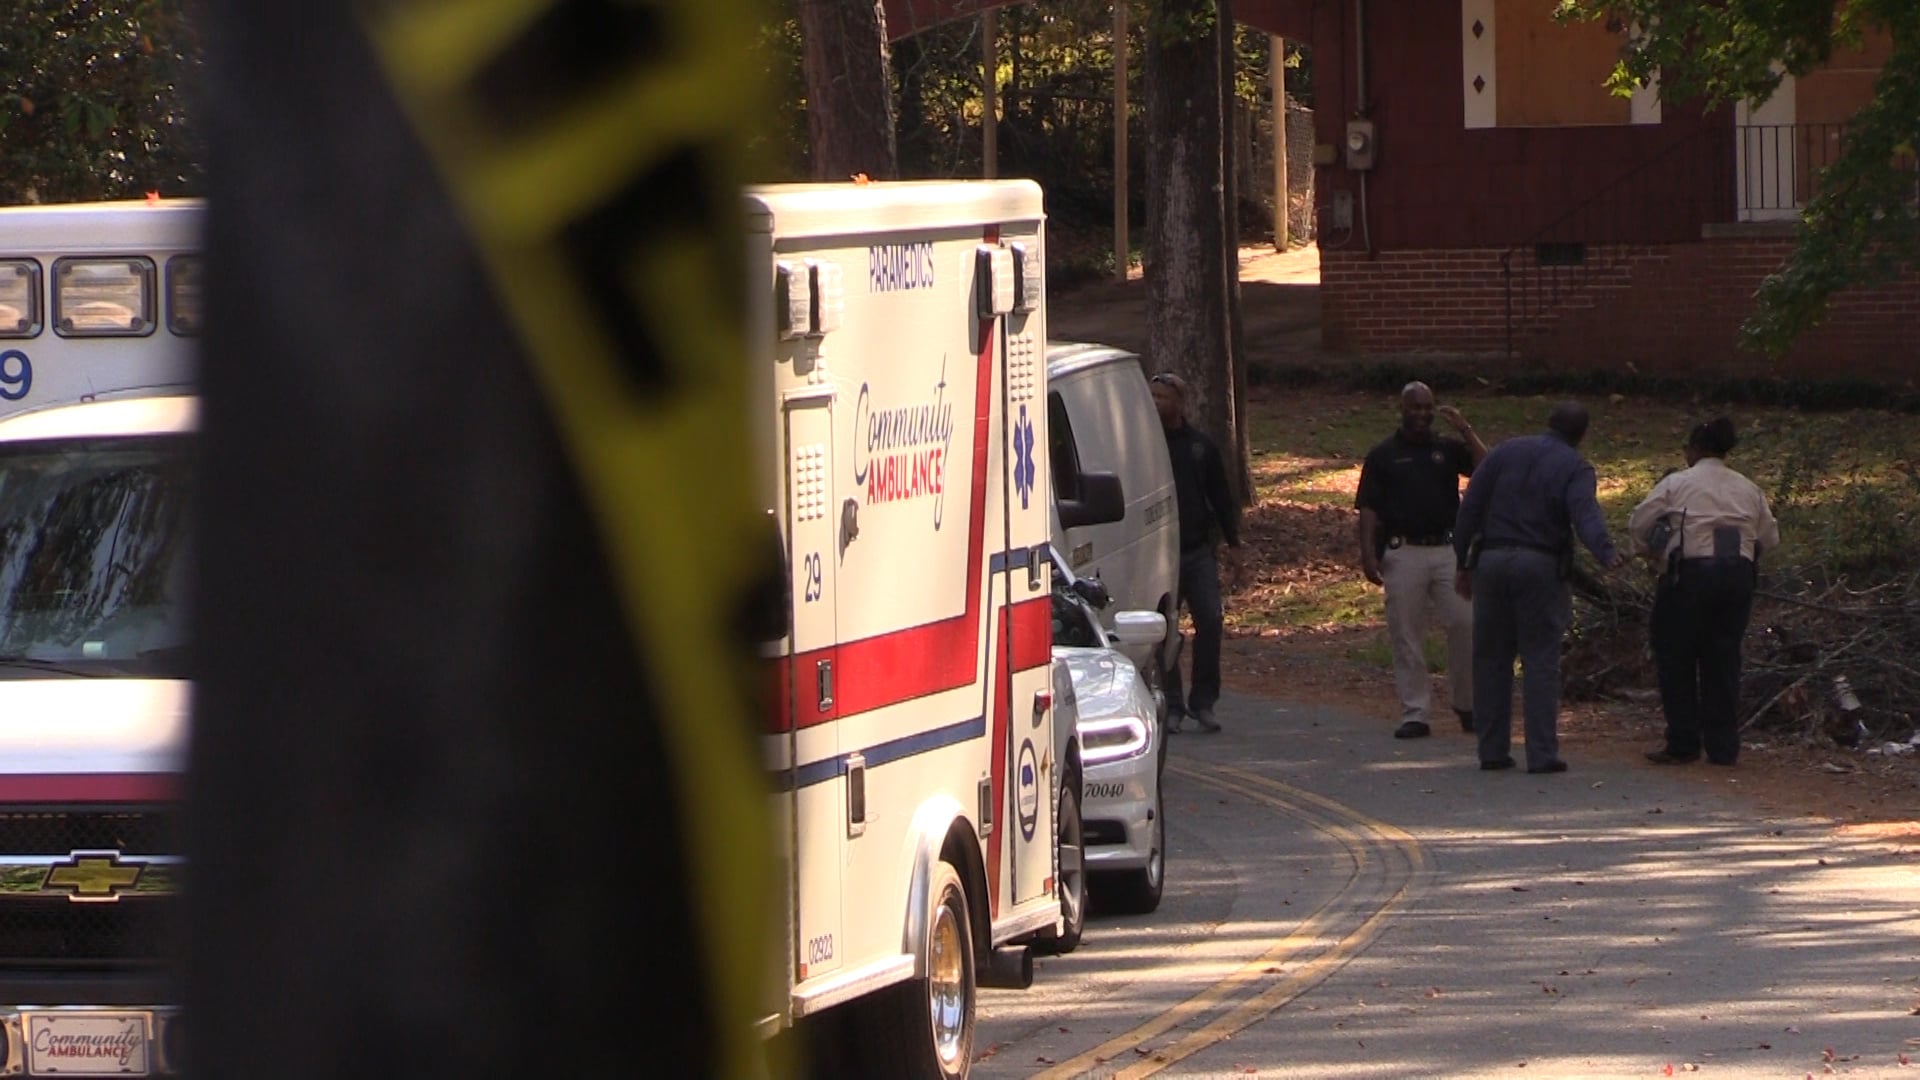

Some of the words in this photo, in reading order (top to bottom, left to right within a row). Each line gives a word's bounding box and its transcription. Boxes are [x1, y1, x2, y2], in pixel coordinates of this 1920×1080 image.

[868, 240, 934, 294] PARAMEDICS
[0, 350, 32, 400] 9
[854, 351, 953, 531] Community
[867, 447, 943, 505] AMBULANCE
[804, 552, 821, 602] 29
[1084, 783, 1124, 798] 70040
[34, 1024, 142, 1066] Community
[48, 1045, 129, 1058] AMBULANCE
